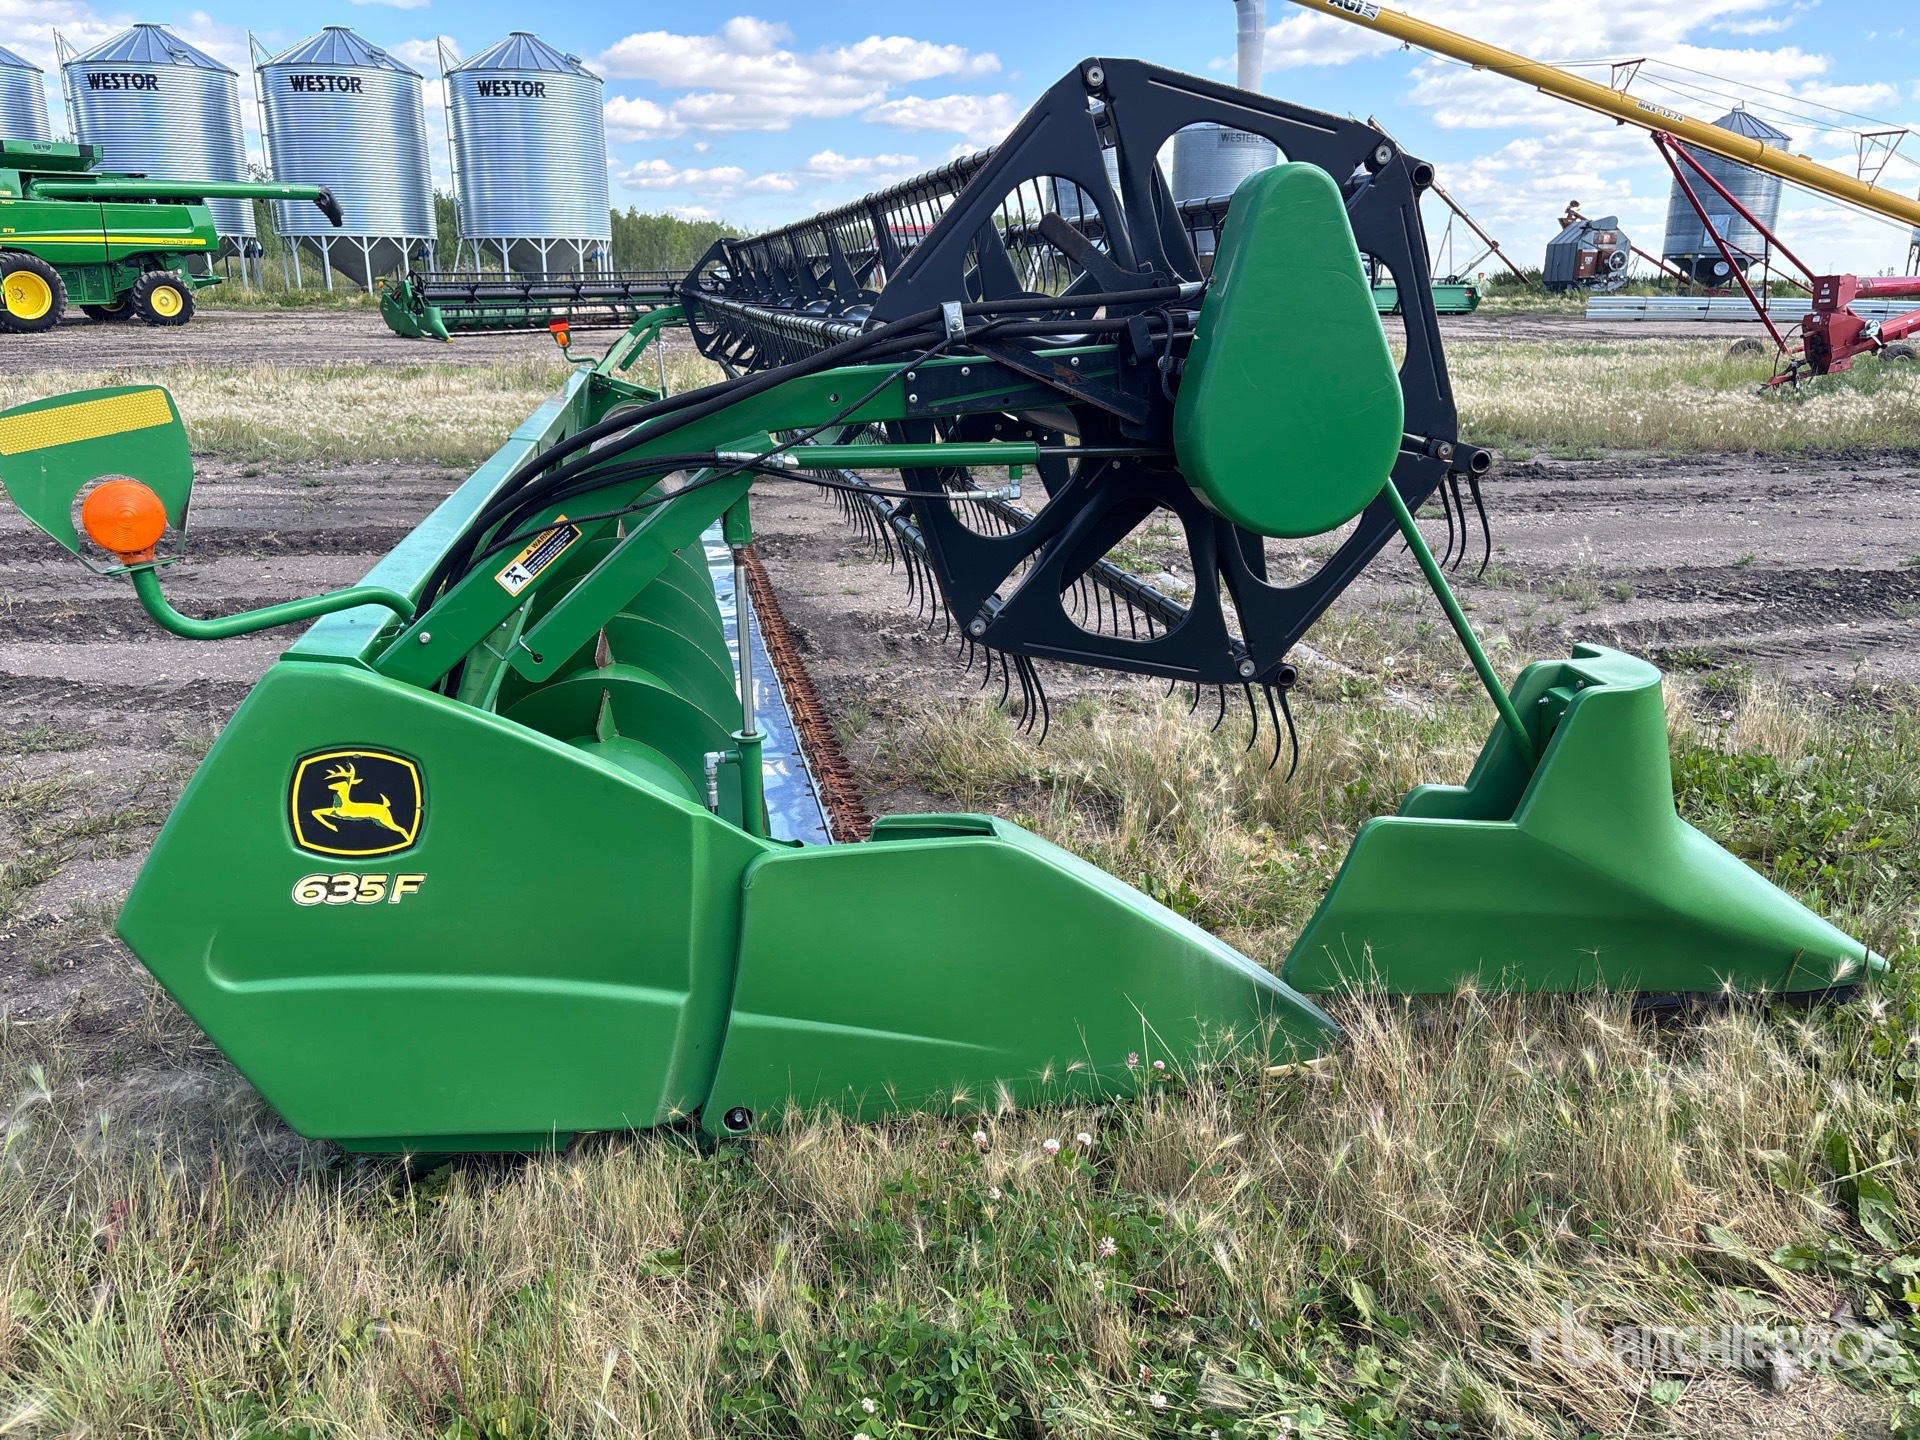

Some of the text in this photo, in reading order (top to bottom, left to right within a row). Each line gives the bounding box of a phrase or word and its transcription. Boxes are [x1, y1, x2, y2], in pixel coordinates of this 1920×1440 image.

[86, 73, 160, 91] WESTOR
[289, 75, 363, 94] WESTOR
[477, 80, 546, 98] WESTOR
